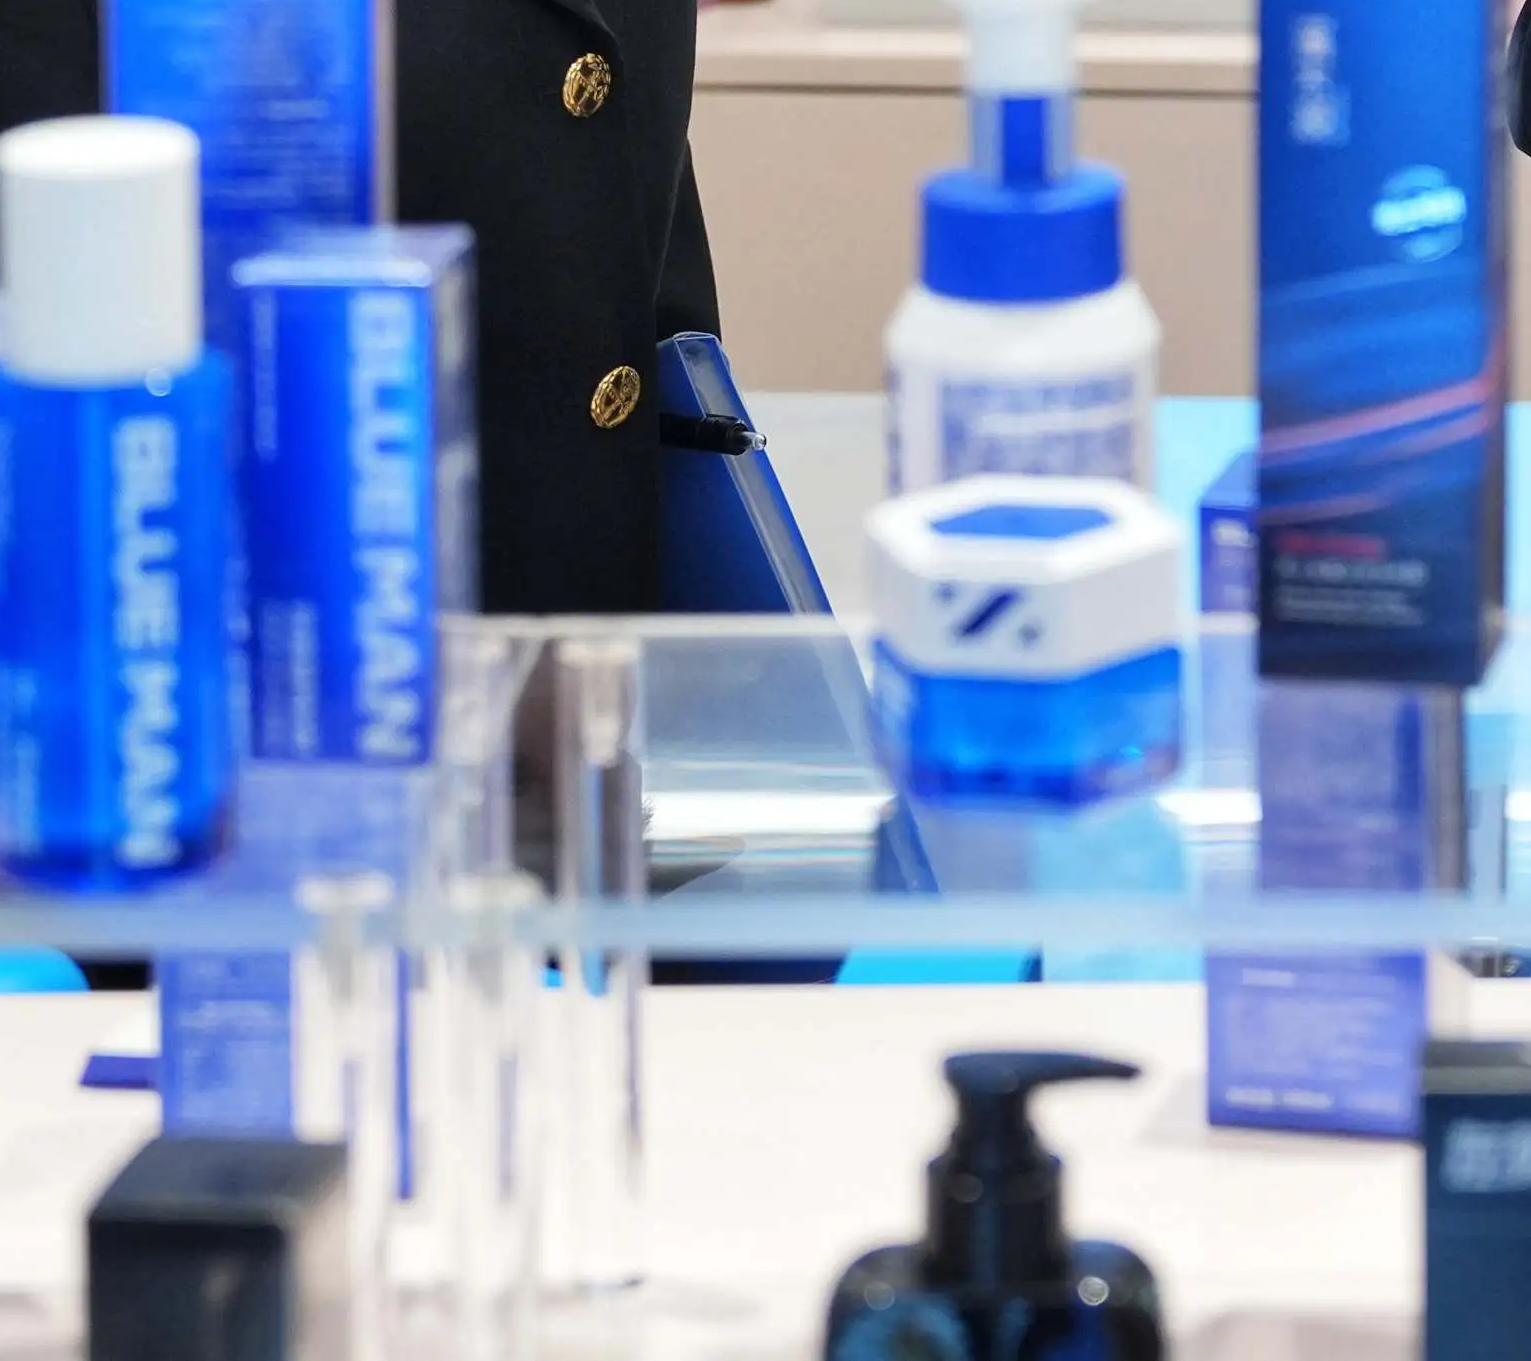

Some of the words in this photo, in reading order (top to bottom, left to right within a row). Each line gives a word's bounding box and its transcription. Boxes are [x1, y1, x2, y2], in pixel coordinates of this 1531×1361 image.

[349, 291, 417, 543] BLUE
[112, 415, 178, 650] BLUE
[118, 659, 180, 867] MAN
[356, 547, 420, 760] MAN
